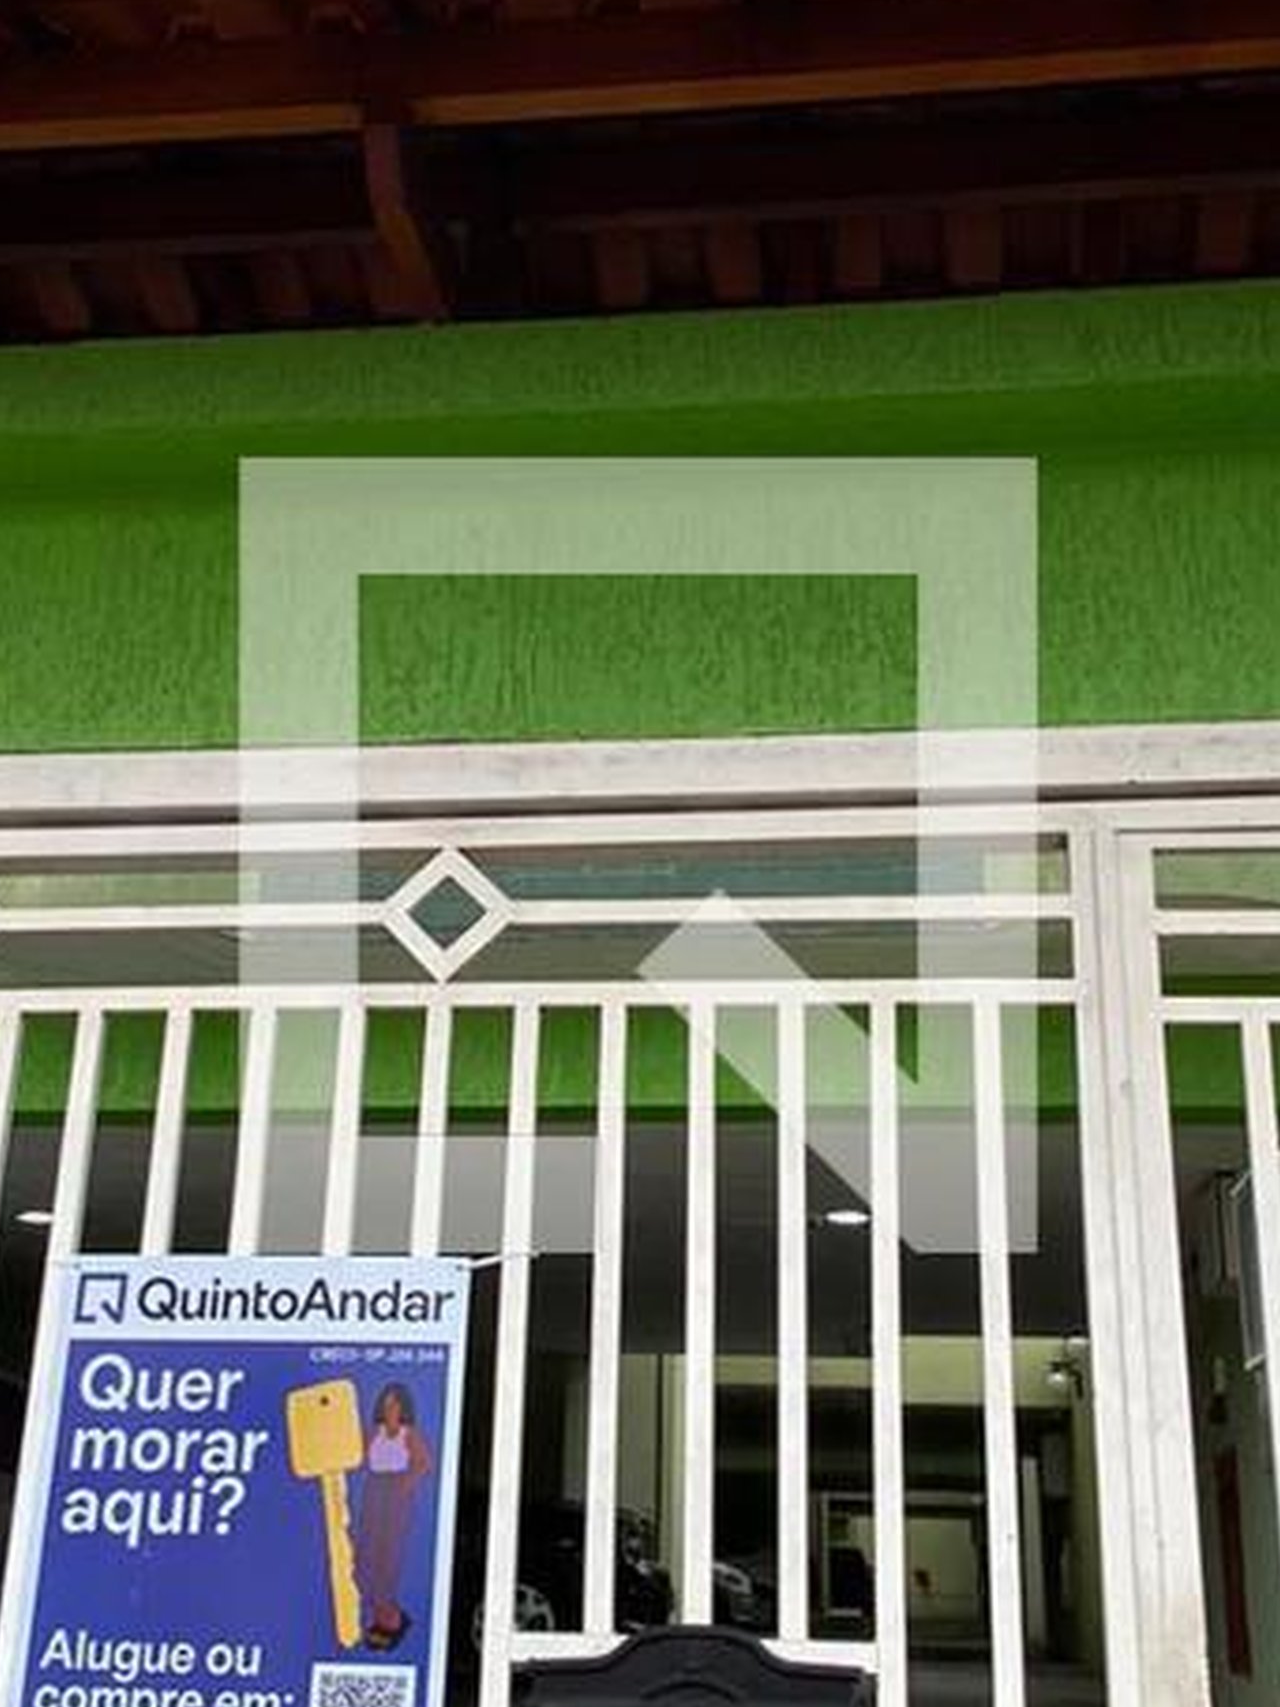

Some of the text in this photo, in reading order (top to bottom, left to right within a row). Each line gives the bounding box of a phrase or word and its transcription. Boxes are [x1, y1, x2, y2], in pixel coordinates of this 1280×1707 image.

[136, 1276, 455, 1325] QuintoAndar
[80, 1353, 243, 1411] Quer
[70, 1428, 269, 1474] morar
[61, 1478, 246, 1548] aqui?
[39, 1630, 261, 1682] Alugue ou
